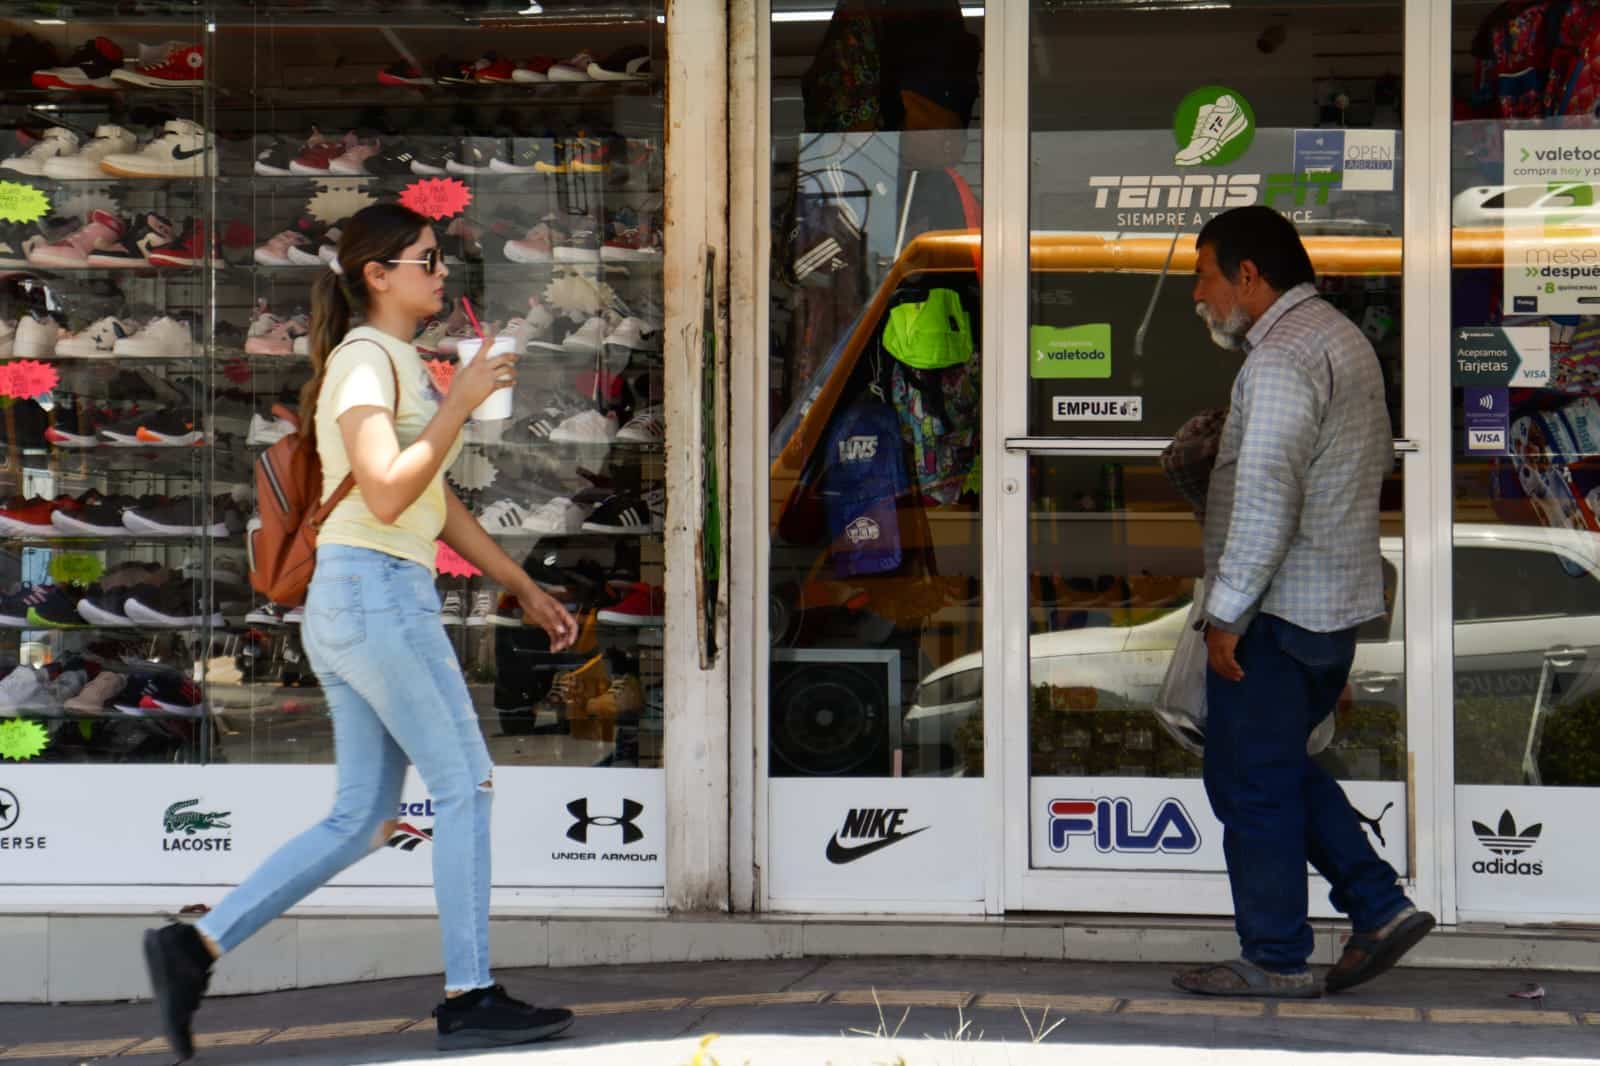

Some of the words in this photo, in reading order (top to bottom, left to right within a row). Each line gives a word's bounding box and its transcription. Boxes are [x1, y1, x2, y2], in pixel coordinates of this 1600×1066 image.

[1347, 145, 1391, 160] OPEN
[1513, 168, 1557, 176] compra
[1089, 174, 1261, 208] TENNIS
[1117, 212, 1185, 226] SIEMPRE
[1193, 212, 1203, 225] A
[1525, 248, 1600, 265] mese
[1540, 265, 1600, 279] despué
[1545, 282, 1555, 294] 8
[1048, 349, 1105, 360] valetodo
[1458, 349, 1508, 358] Aceptamos
[1457, 360, 1509, 374] Tarjetas
[1523, 370, 1547, 379] VISA
[1057, 402, 1118, 415] EMPUJE
[1475, 433, 1501, 443] VISA
[840, 808, 908, 838] NIKE
[1049, 797, 1202, 854] FILA
[0, 836, 47, 849] ERSE
[163, 838, 232, 851] LACOSTE
[551, 852, 597, 860] UNDER
[601, 853, 658, 862] ARMOUR
[1472, 858, 1543, 876] adidas
